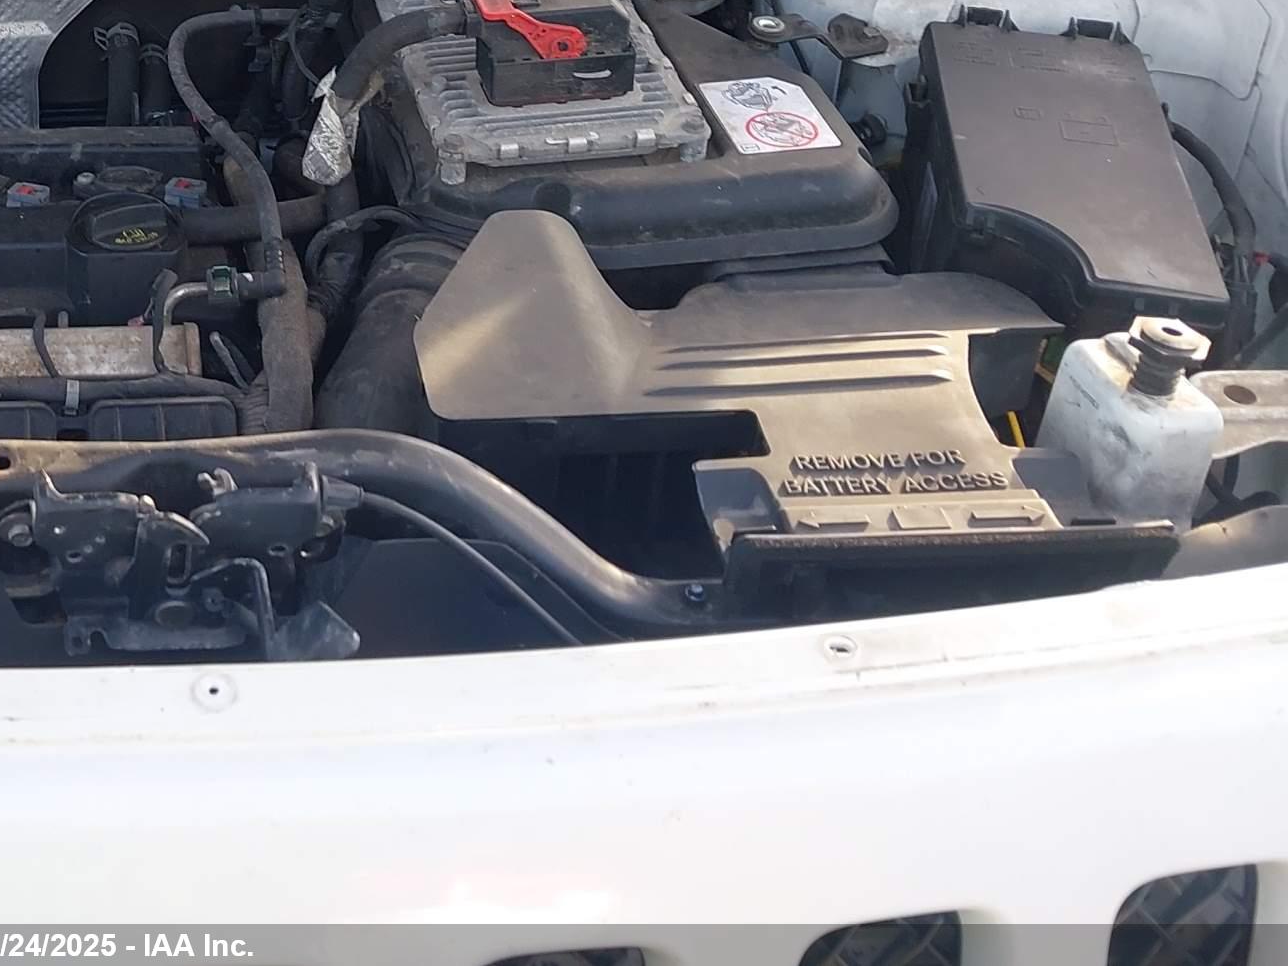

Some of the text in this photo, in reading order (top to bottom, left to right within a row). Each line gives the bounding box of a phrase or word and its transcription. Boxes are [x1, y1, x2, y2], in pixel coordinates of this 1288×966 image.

[790, 449, 967, 472] REMOVE FOR
[781, 471, 1009, 496] BATTERY ACCESS
